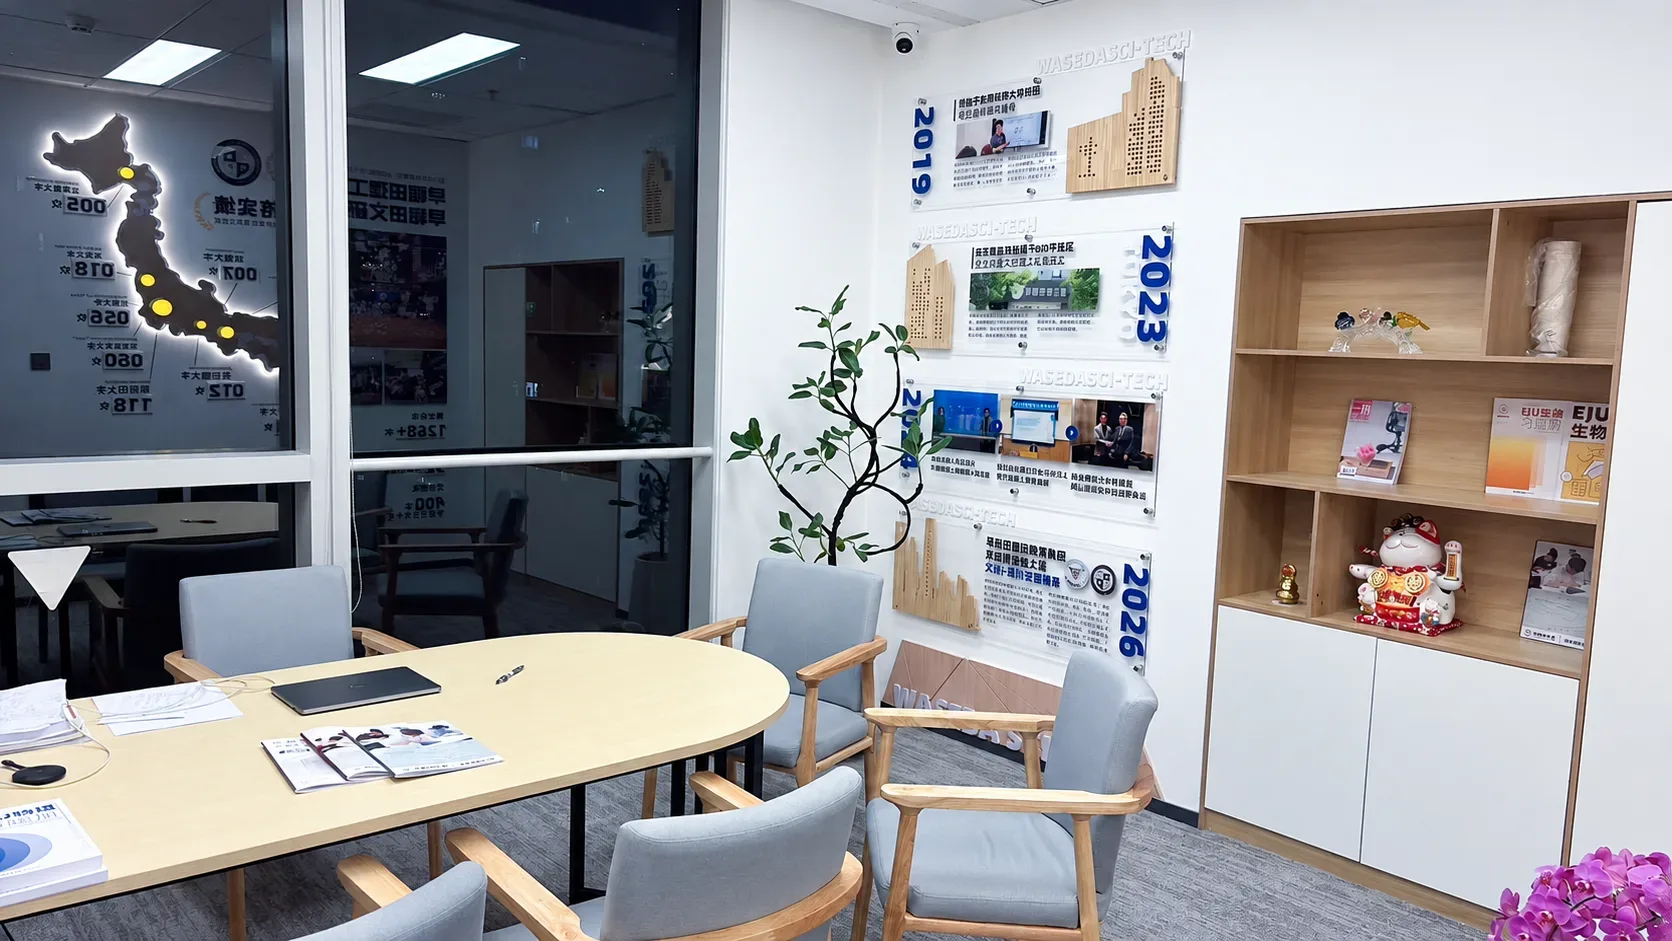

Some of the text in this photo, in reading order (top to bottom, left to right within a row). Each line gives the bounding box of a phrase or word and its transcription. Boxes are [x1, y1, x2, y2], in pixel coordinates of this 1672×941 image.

[912, 106, 935, 195] 2019
[1137, 235, 1172, 343] 2023
[901, 388, 921, 469] 204
[1570, 423, 1607, 440] 生物
[1572, 405, 1608, 424] EJU
[1119, 563, 1149, 658] 2026
